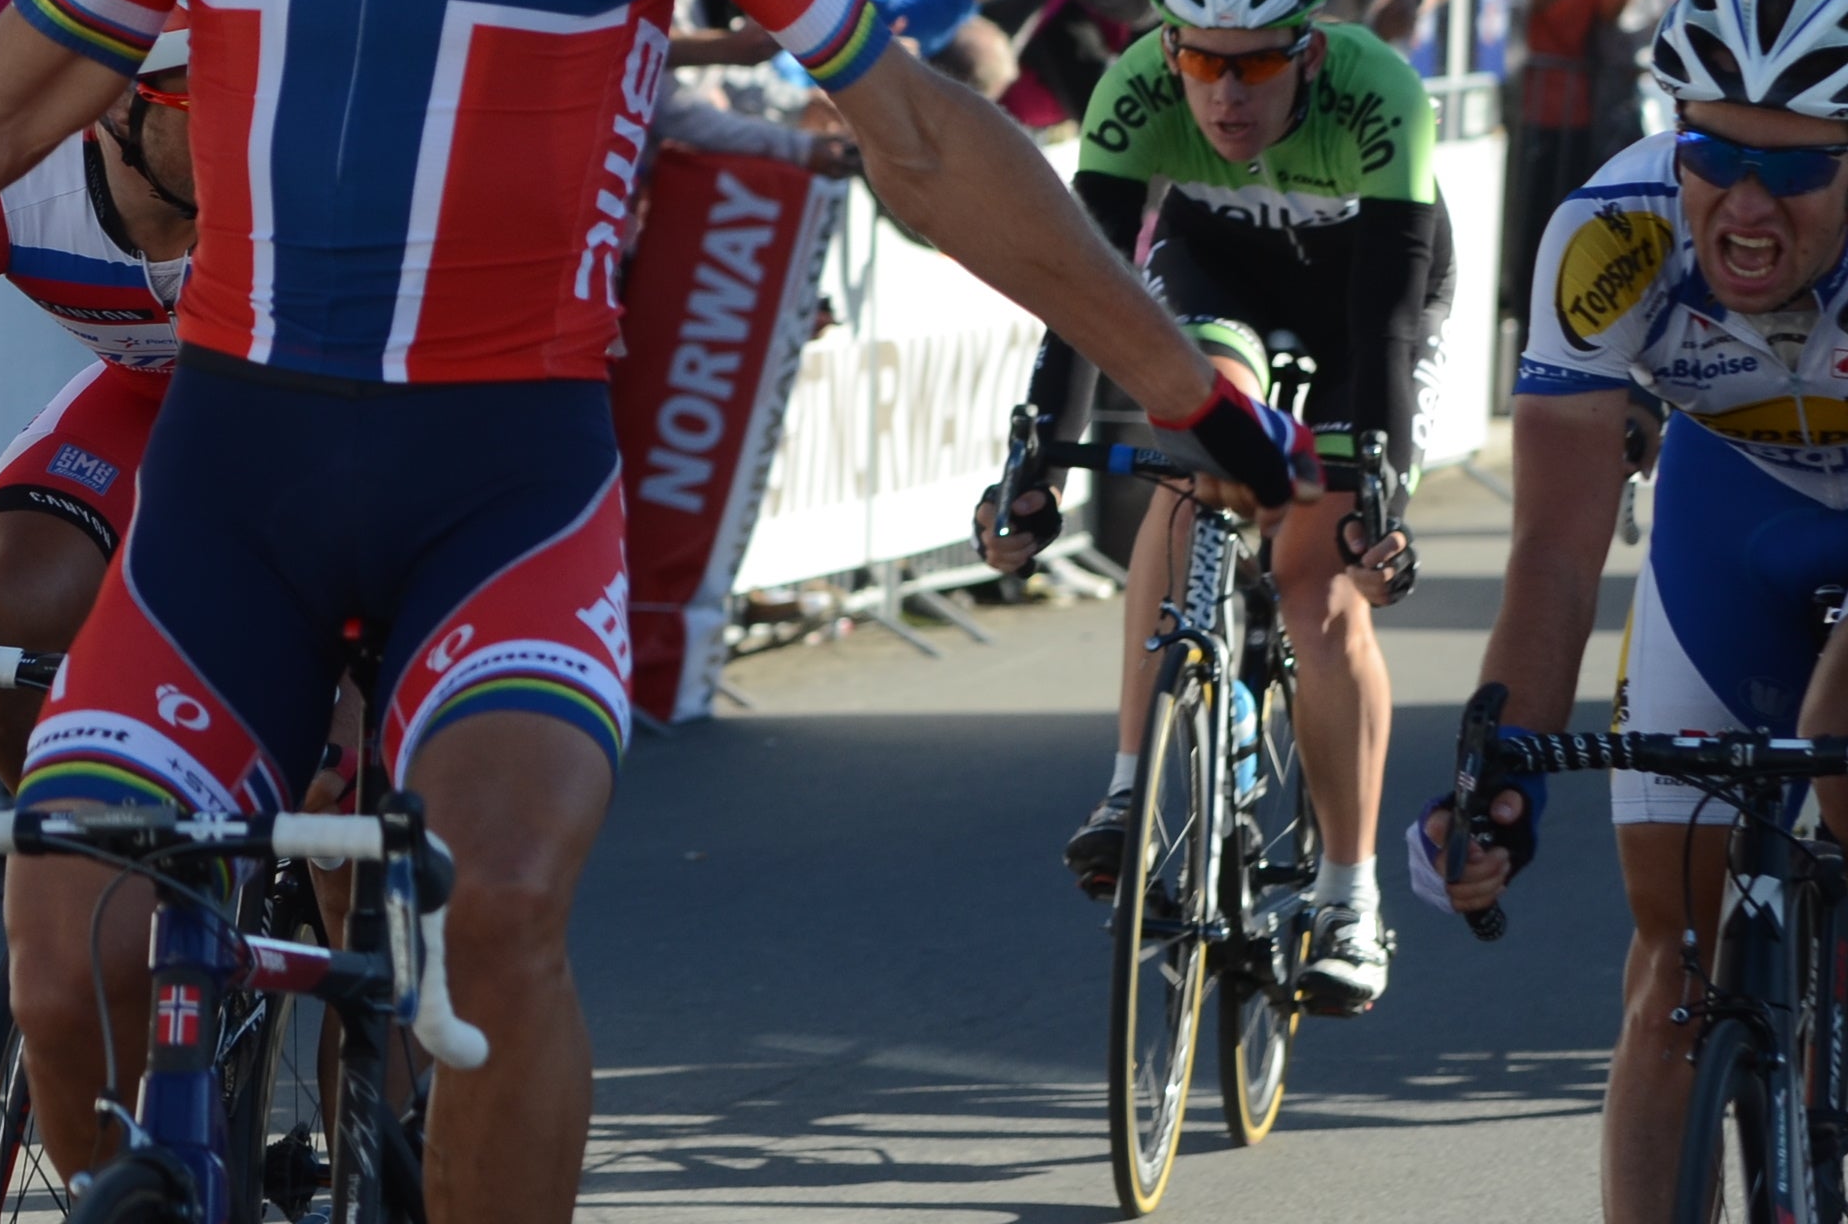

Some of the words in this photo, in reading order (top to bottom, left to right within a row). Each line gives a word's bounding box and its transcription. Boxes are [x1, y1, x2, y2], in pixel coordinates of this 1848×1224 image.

[1317, 68, 1402, 175] belkin
[1570, 236, 1657, 328] Topsport
[638, 171, 783, 514] NORWAY
[28, 490, 112, 550] CANYON
